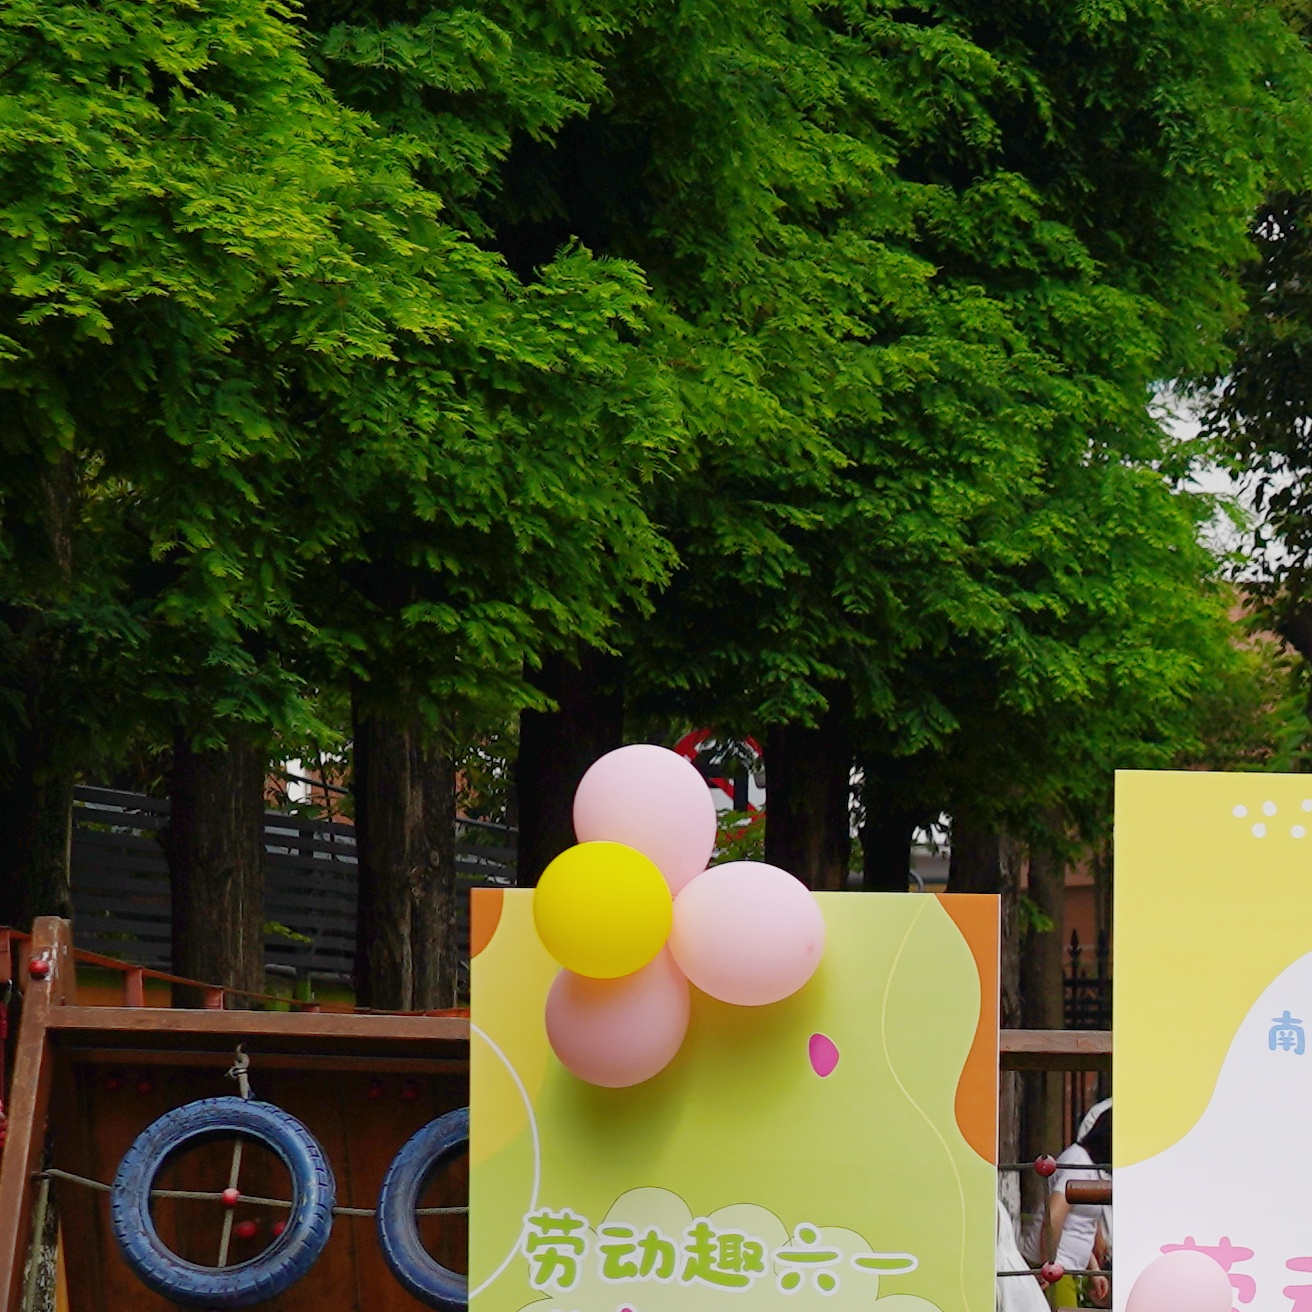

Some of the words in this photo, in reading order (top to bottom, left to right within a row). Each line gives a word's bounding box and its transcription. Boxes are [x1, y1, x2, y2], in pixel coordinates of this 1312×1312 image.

[525, 1213, 914, 1291] 劳动趣六一
